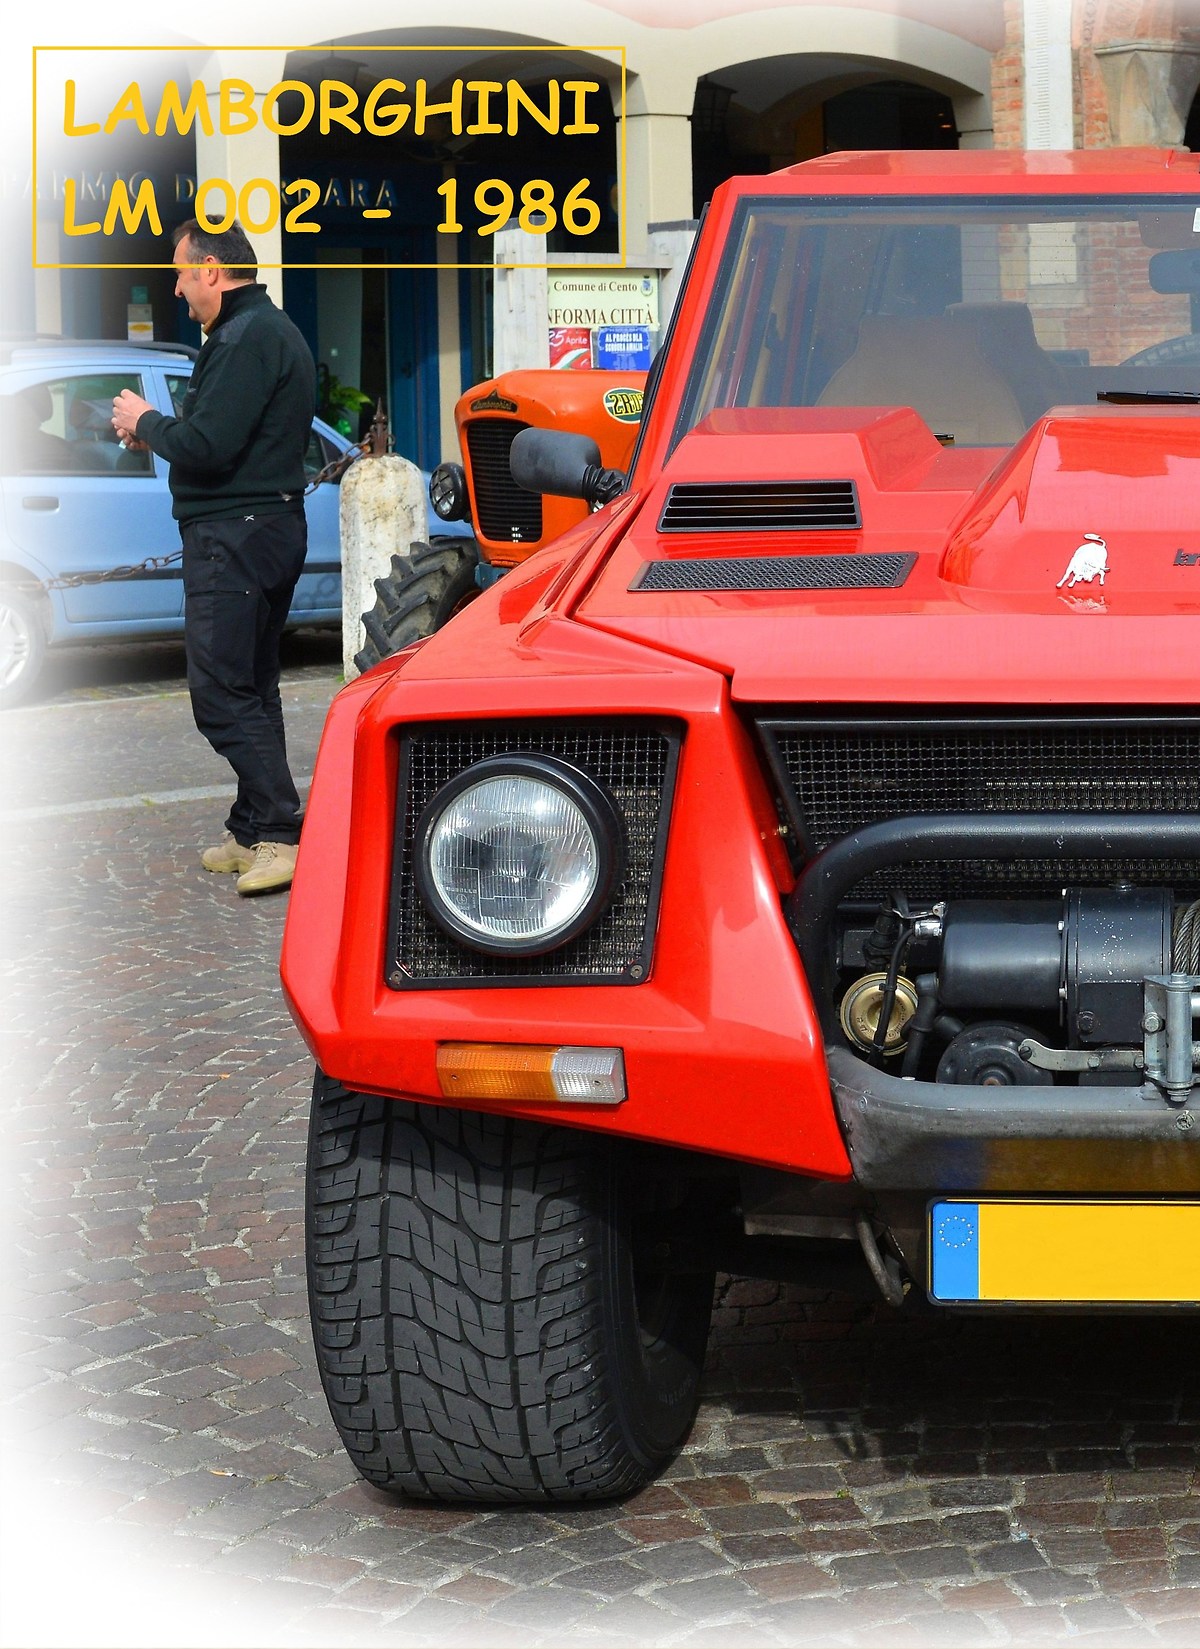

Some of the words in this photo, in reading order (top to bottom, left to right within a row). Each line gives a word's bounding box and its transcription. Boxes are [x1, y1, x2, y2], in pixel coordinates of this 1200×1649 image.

[553, 281, 596, 292] Comune
[598, 282, 607, 292] di
[608, 281, 638, 292] Cento
[548, 308, 606, 325] NFORMA
[610, 303, 654, 325] CITTÀ
[565, 336, 588, 345] Aprile
